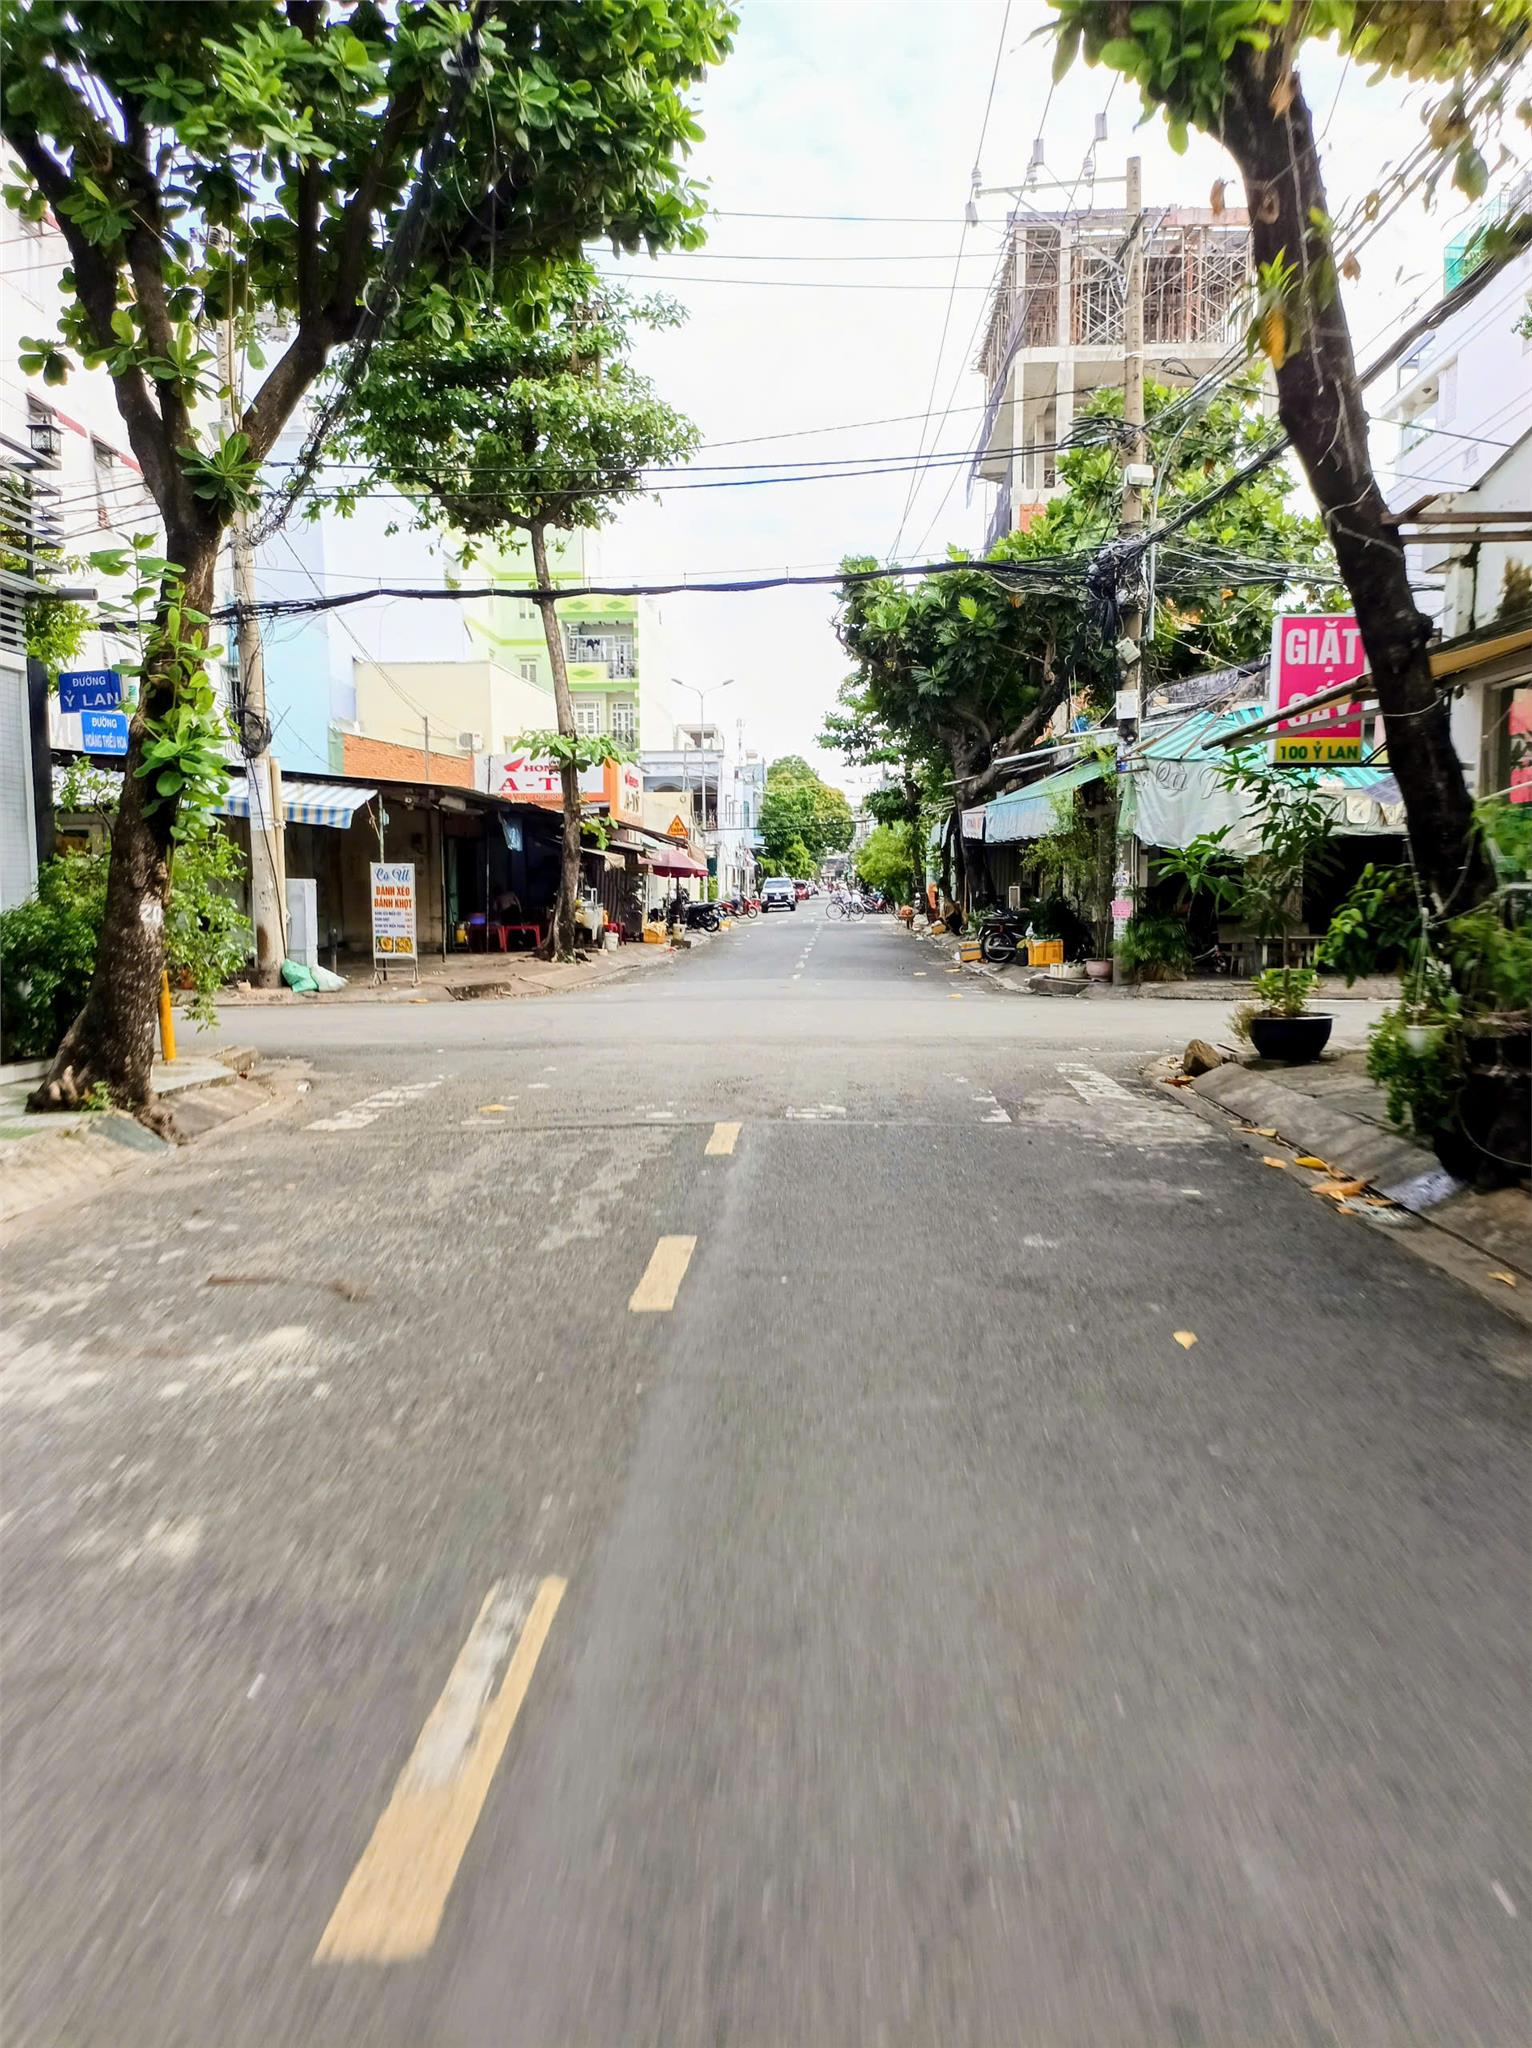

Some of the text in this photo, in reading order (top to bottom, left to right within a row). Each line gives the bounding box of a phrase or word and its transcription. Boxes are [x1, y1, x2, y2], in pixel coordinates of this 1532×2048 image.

[1285, 621, 1361, 673] GIẶT
[72, 676, 106, 687] ĐƯỜNG
[82, 692, 121, 707] LAN
[91, 716, 117, 728] ĐƯỜNG
[1280, 746, 1307, 759] 100
[1328, 746, 1358, 759] LAN
